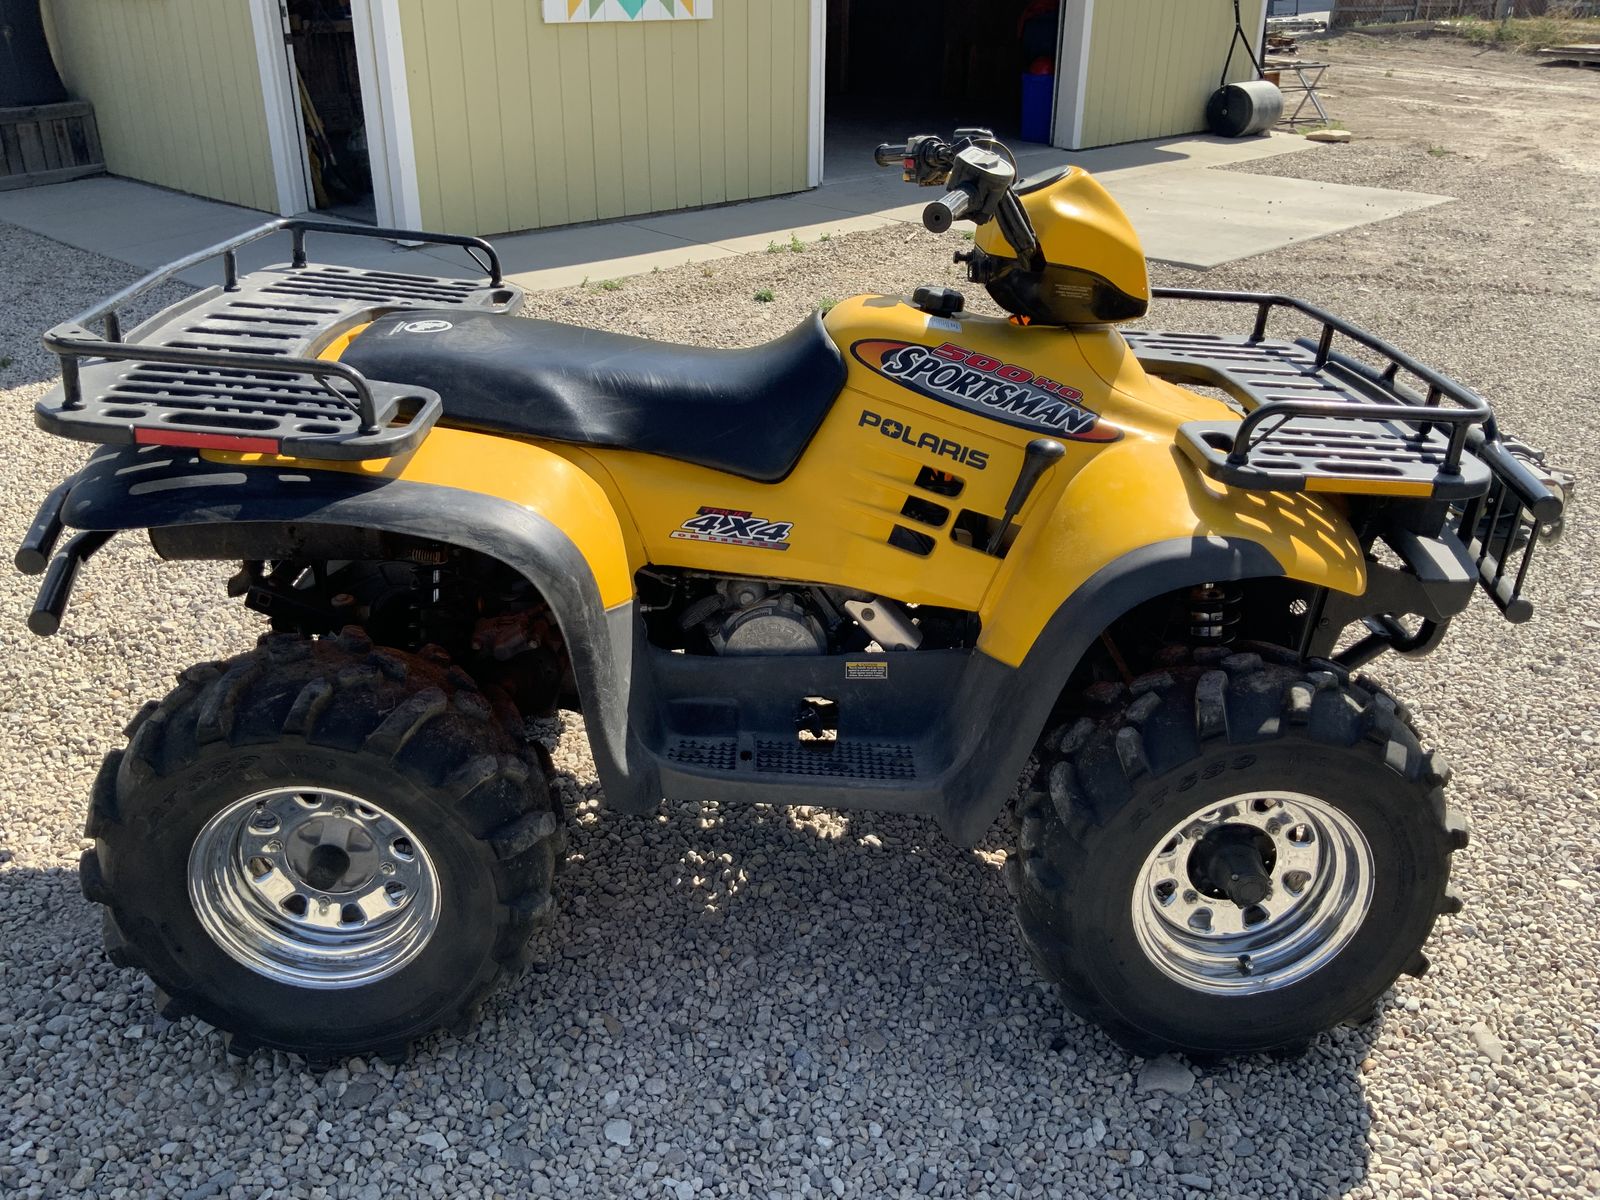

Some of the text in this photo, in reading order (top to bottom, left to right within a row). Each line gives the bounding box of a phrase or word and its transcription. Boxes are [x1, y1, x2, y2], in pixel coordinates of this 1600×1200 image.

[881, 346, 1098, 433] SPORTSMAN
[930, 342, 1034, 384] 500
[858, 410, 990, 470] POLARIS
